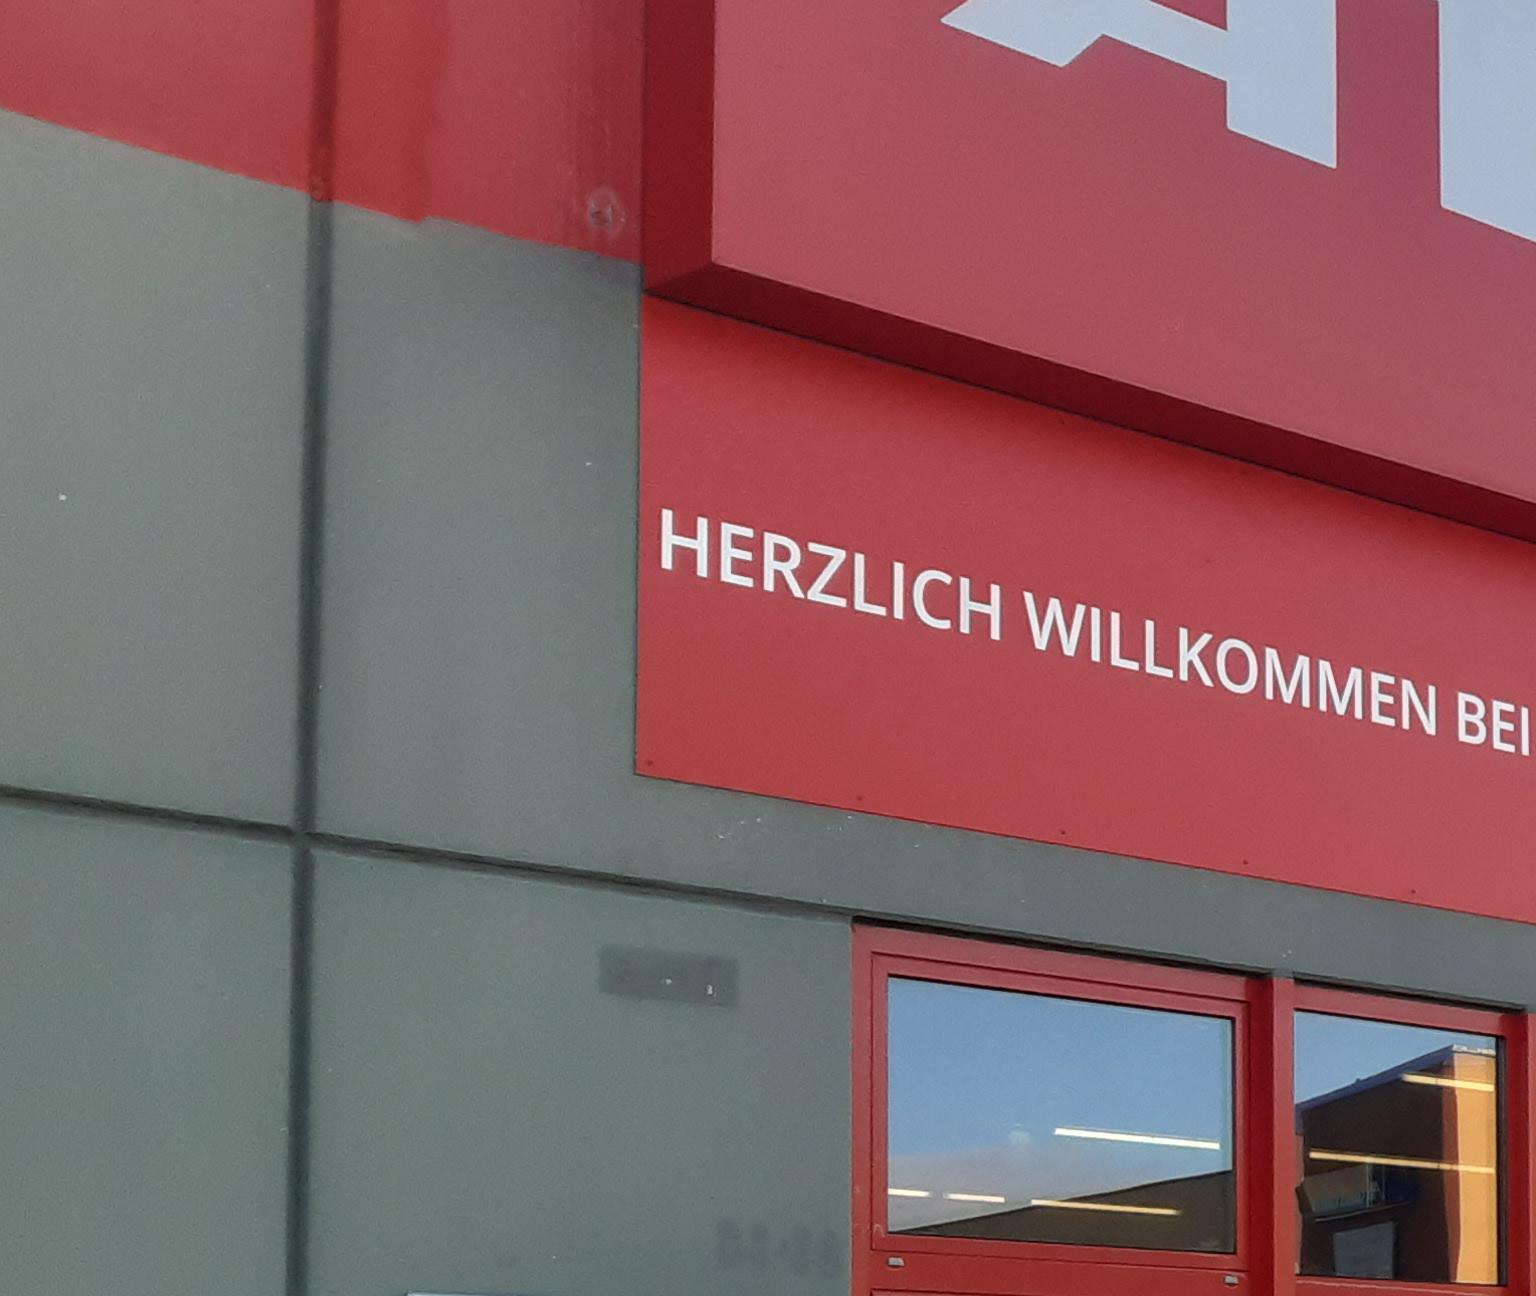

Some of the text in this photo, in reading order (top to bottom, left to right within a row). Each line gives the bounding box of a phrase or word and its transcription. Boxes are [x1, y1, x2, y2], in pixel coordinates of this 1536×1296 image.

[659, 507, 1003, 642] HERZLICH
[1022, 589, 1438, 737] WILLKOMMEN
[1454, 690, 1533, 756] BEI
